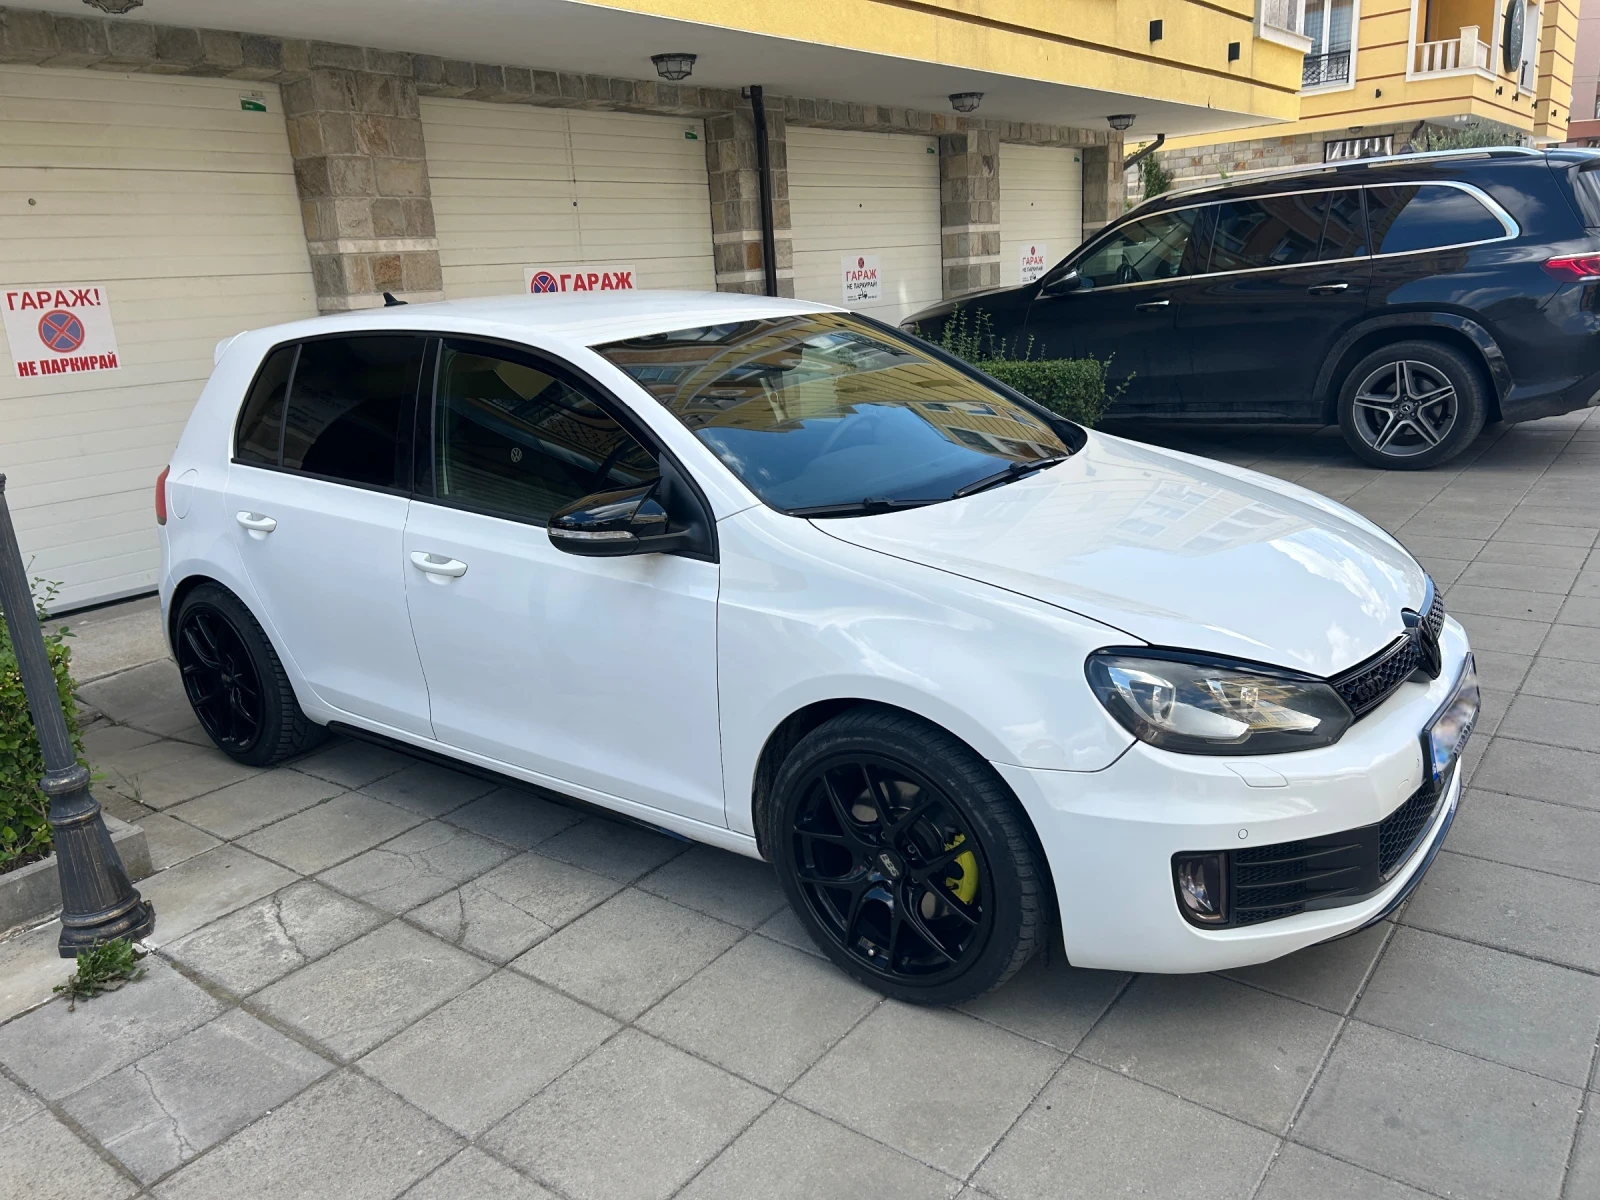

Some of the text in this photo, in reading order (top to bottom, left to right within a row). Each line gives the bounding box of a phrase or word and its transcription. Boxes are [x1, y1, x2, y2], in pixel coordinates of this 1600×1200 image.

[560, 272, 633, 292] ГАРАЖ
[846, 269, 877, 281] ГАРАЖ
[6, 288, 101, 310] ГАРАЖ!
[17, 351, 118, 377] НЕ ПАРКИРАЙ
[880, 853, 900, 877] BBS
